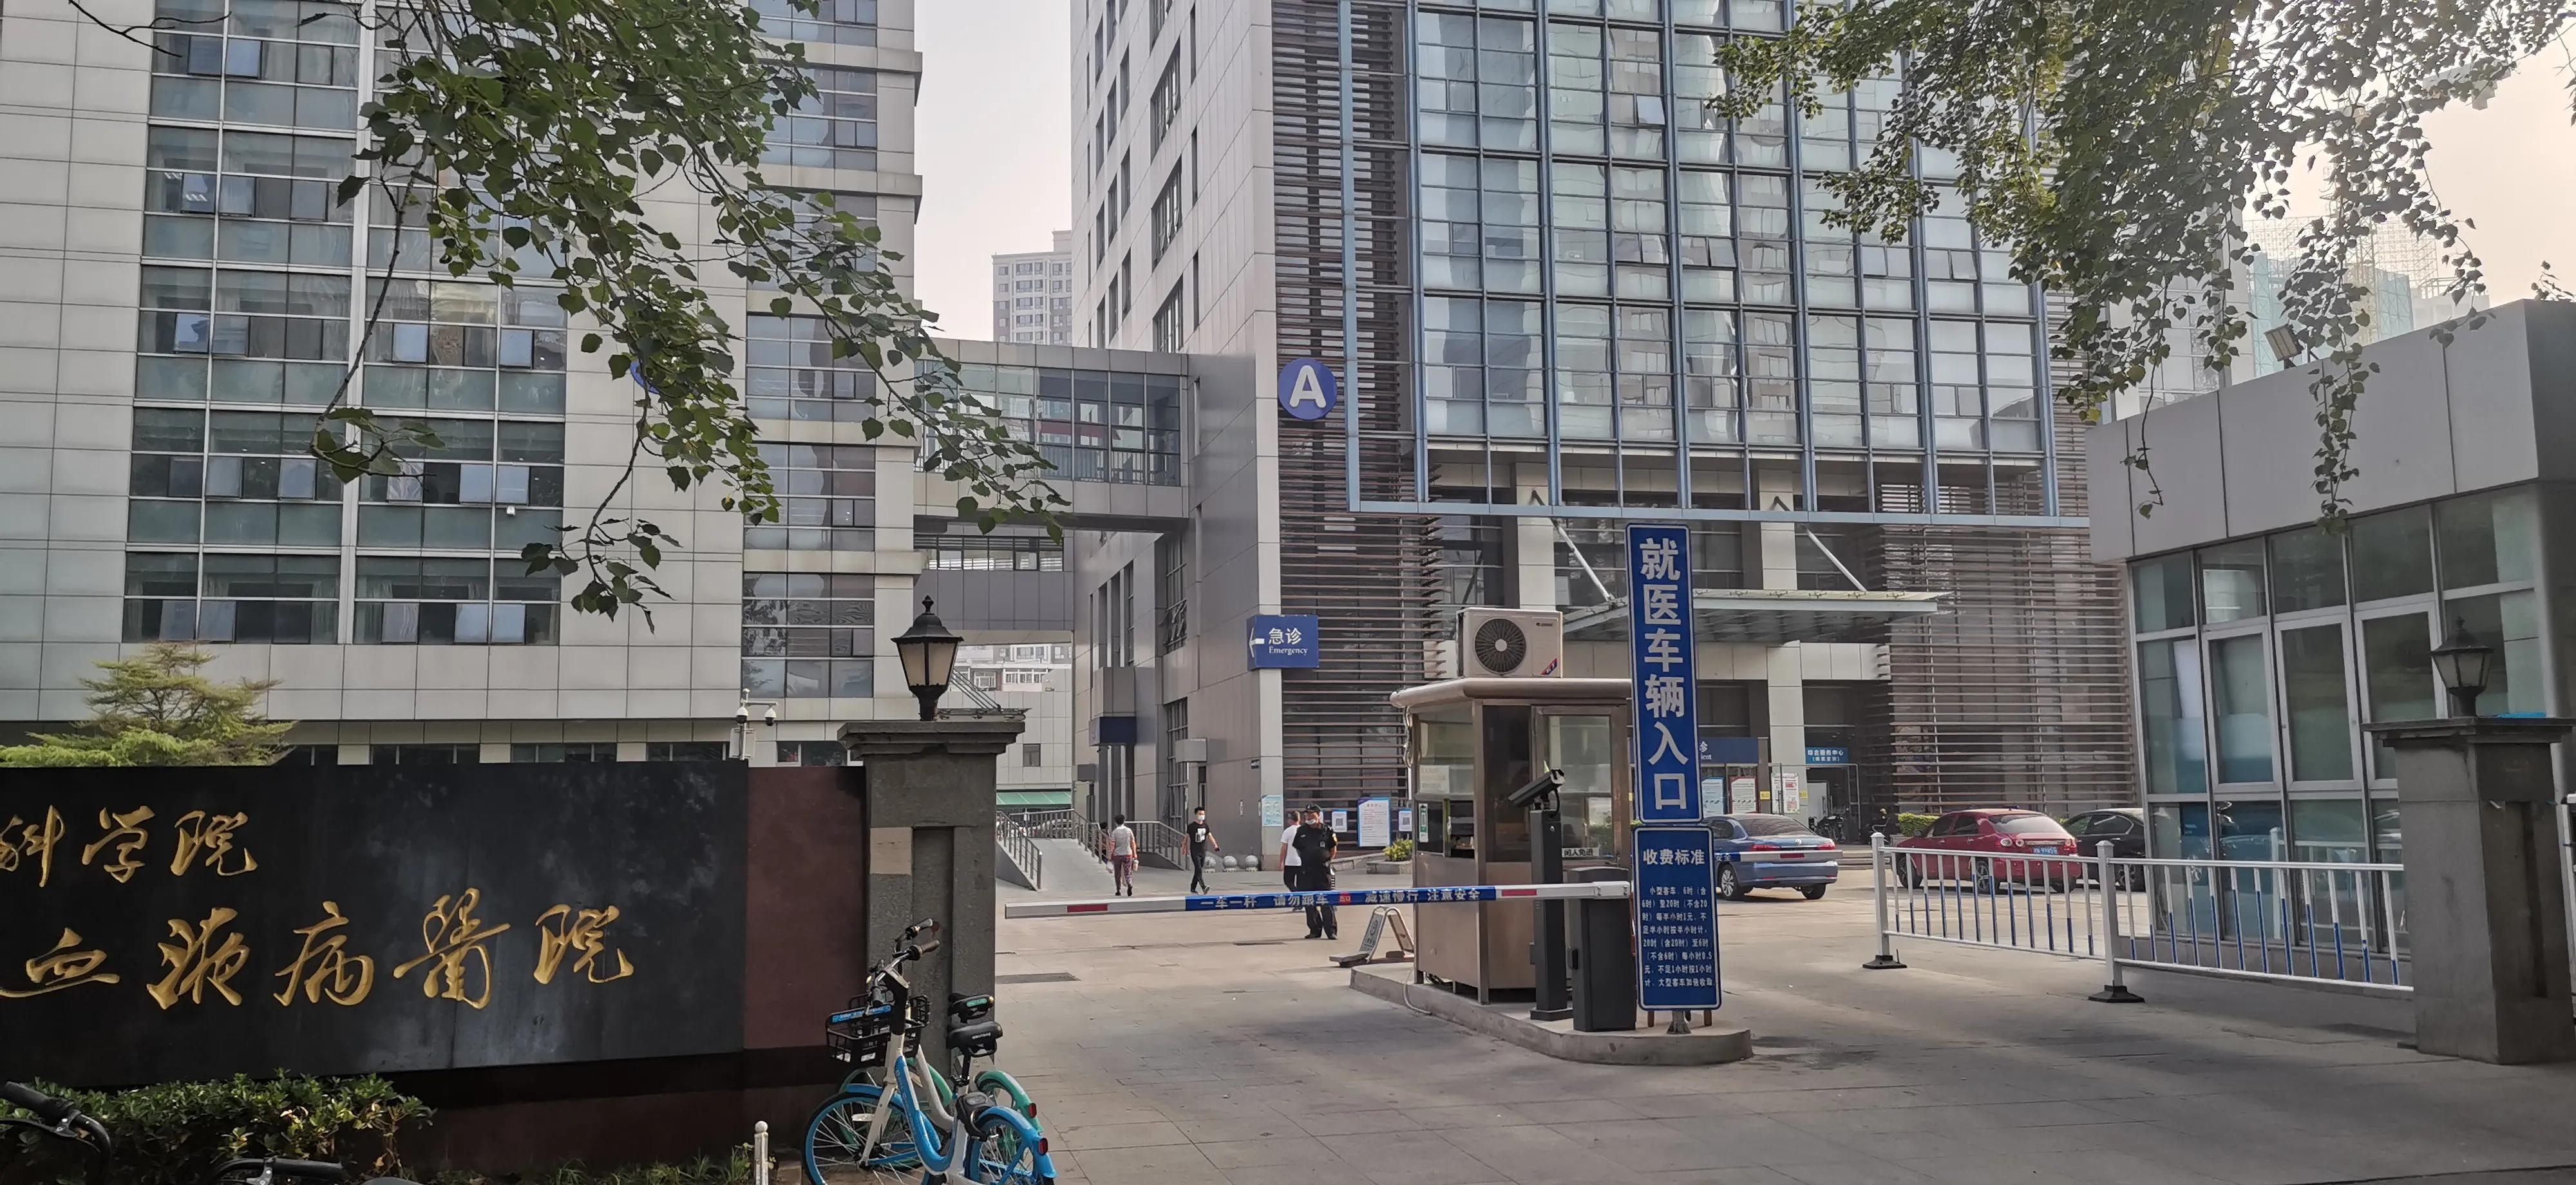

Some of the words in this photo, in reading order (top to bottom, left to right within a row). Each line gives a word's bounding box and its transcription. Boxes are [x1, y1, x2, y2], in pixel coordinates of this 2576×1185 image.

[1289, 365, 1327, 408] A
[1268, 627, 1302, 645] 急诊
[1269, 646, 1308, 656] Emergency
[1639, 537, 1689, 810] 就医车辆入口
[1643, 849, 1705, 866] 收费标准
[1200, 896, 1258, 909] 一车一杆
